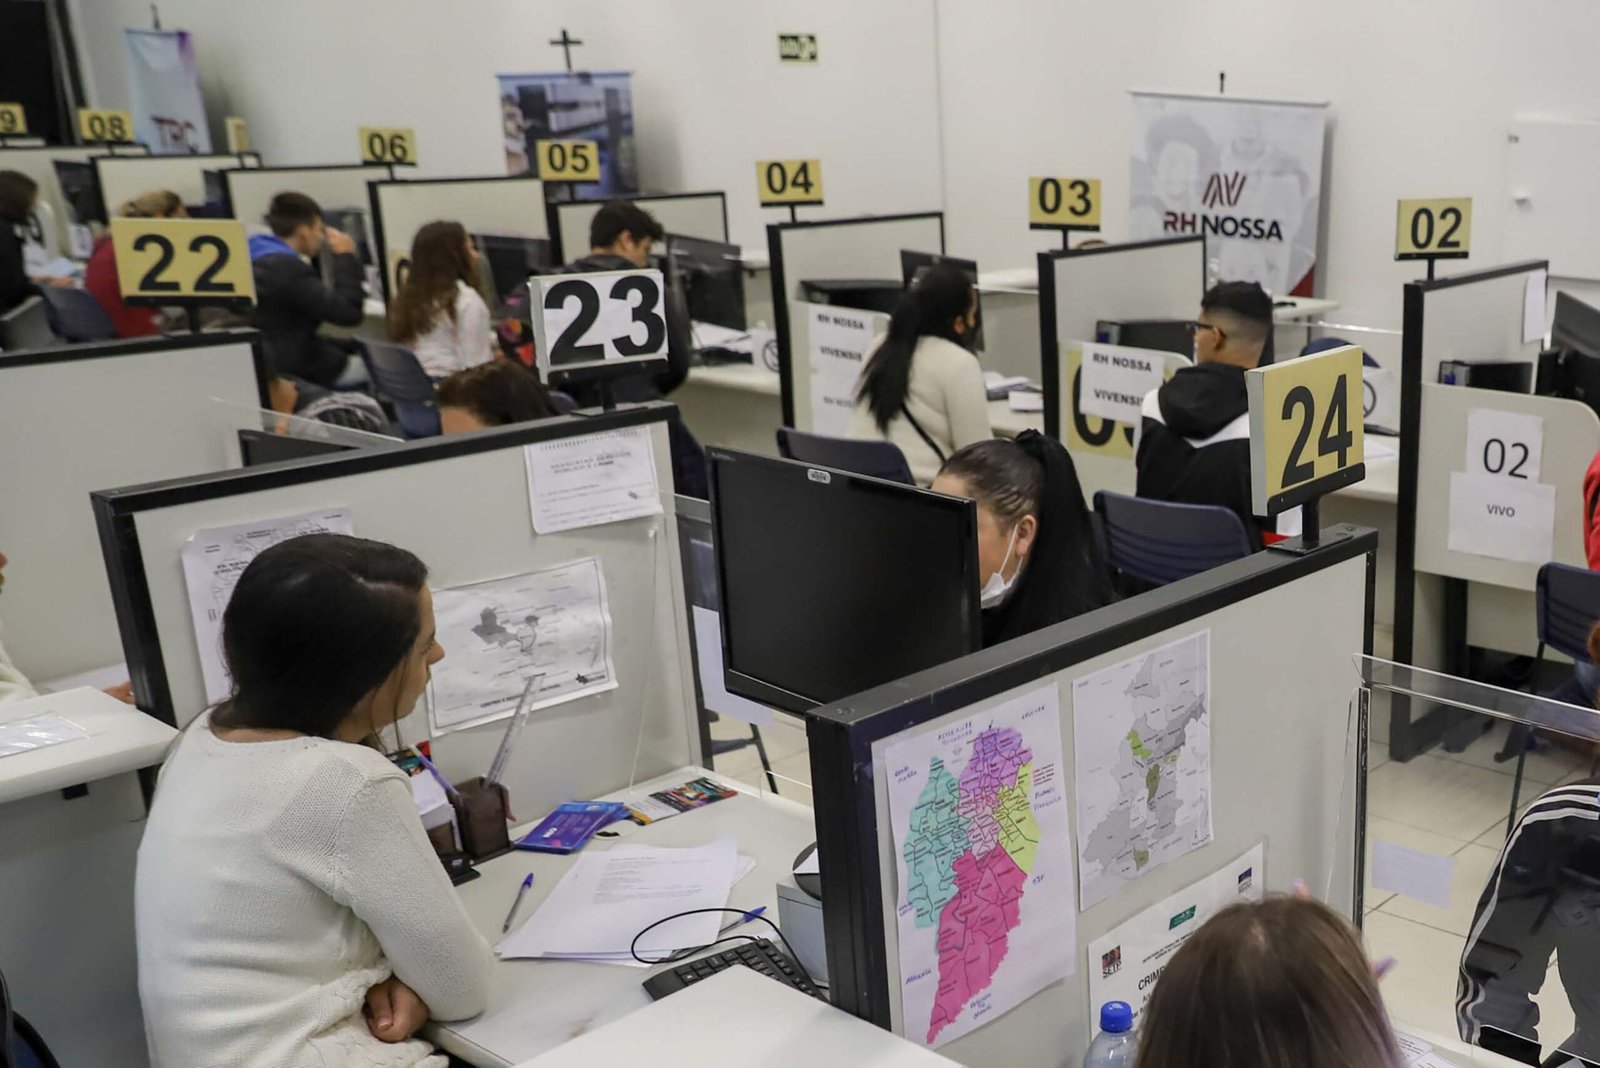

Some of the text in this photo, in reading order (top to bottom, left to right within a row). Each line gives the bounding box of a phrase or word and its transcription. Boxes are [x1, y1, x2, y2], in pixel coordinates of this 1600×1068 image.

[89, 115, 126, 140] 08
[368, 133, 408, 162] 06
[548, 143, 590, 173] 05
[765, 162, 813, 194] 04
[1038, 178, 1092, 216] 03
[1410, 207, 1463, 249] 02
[132, 234, 236, 293] 22
[543, 275, 667, 366] 23
[833, 316, 865, 331] NOSSA
[1092, 353, 1152, 372] RH NOSSA
[1093, 388, 1145, 407] VIVENSI
[1281, 373, 1353, 489] 24
[1482, 438, 1529, 480] 02
[1486, 503, 1516, 518] VIVO
